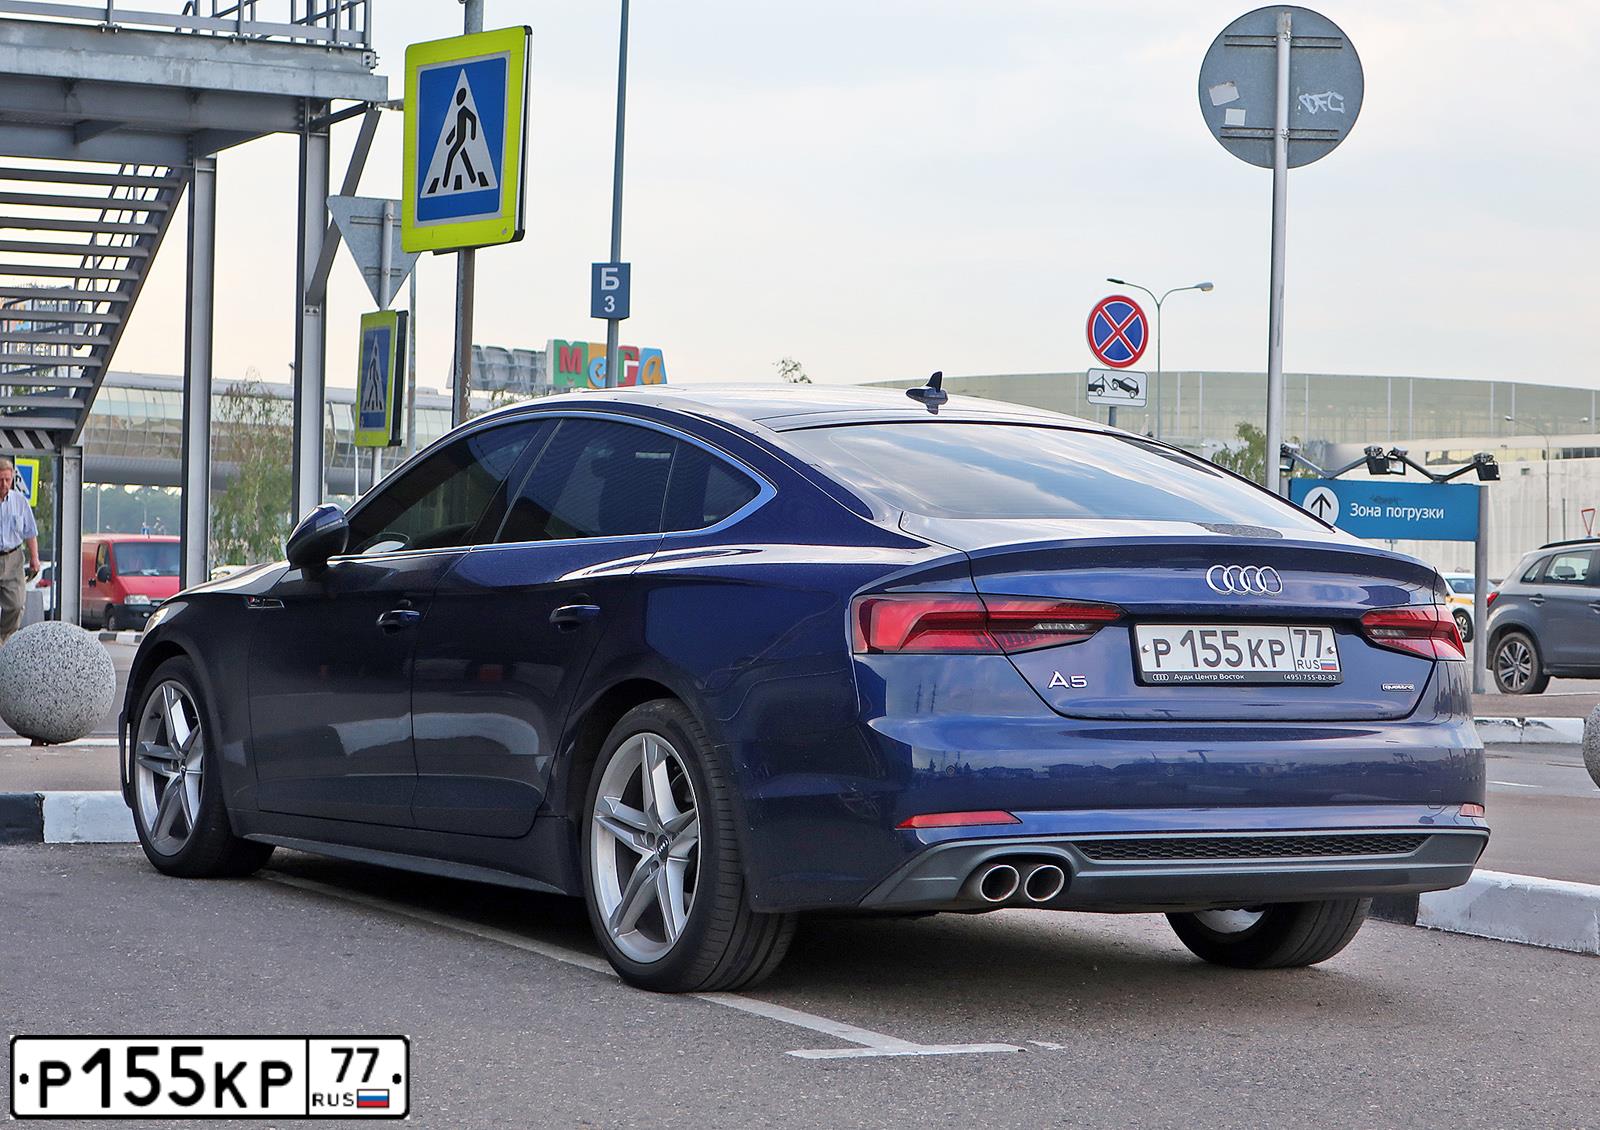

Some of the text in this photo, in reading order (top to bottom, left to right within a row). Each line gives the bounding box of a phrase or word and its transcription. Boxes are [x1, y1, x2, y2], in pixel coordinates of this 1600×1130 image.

[601, 267, 620, 290] Б
[604, 295, 615, 313] 3
[1350, 502, 1445, 521] Зона погрузки
[1293, 629, 1323, 658] 77
[1297, 659, 1320, 670] RUS
[1048, 670, 1088, 689] A5
[1174, 673, 1194, 681] Ауди
[1194, 673, 1218, 681] Центр
[1283, 673, 1302, 682] (495)
